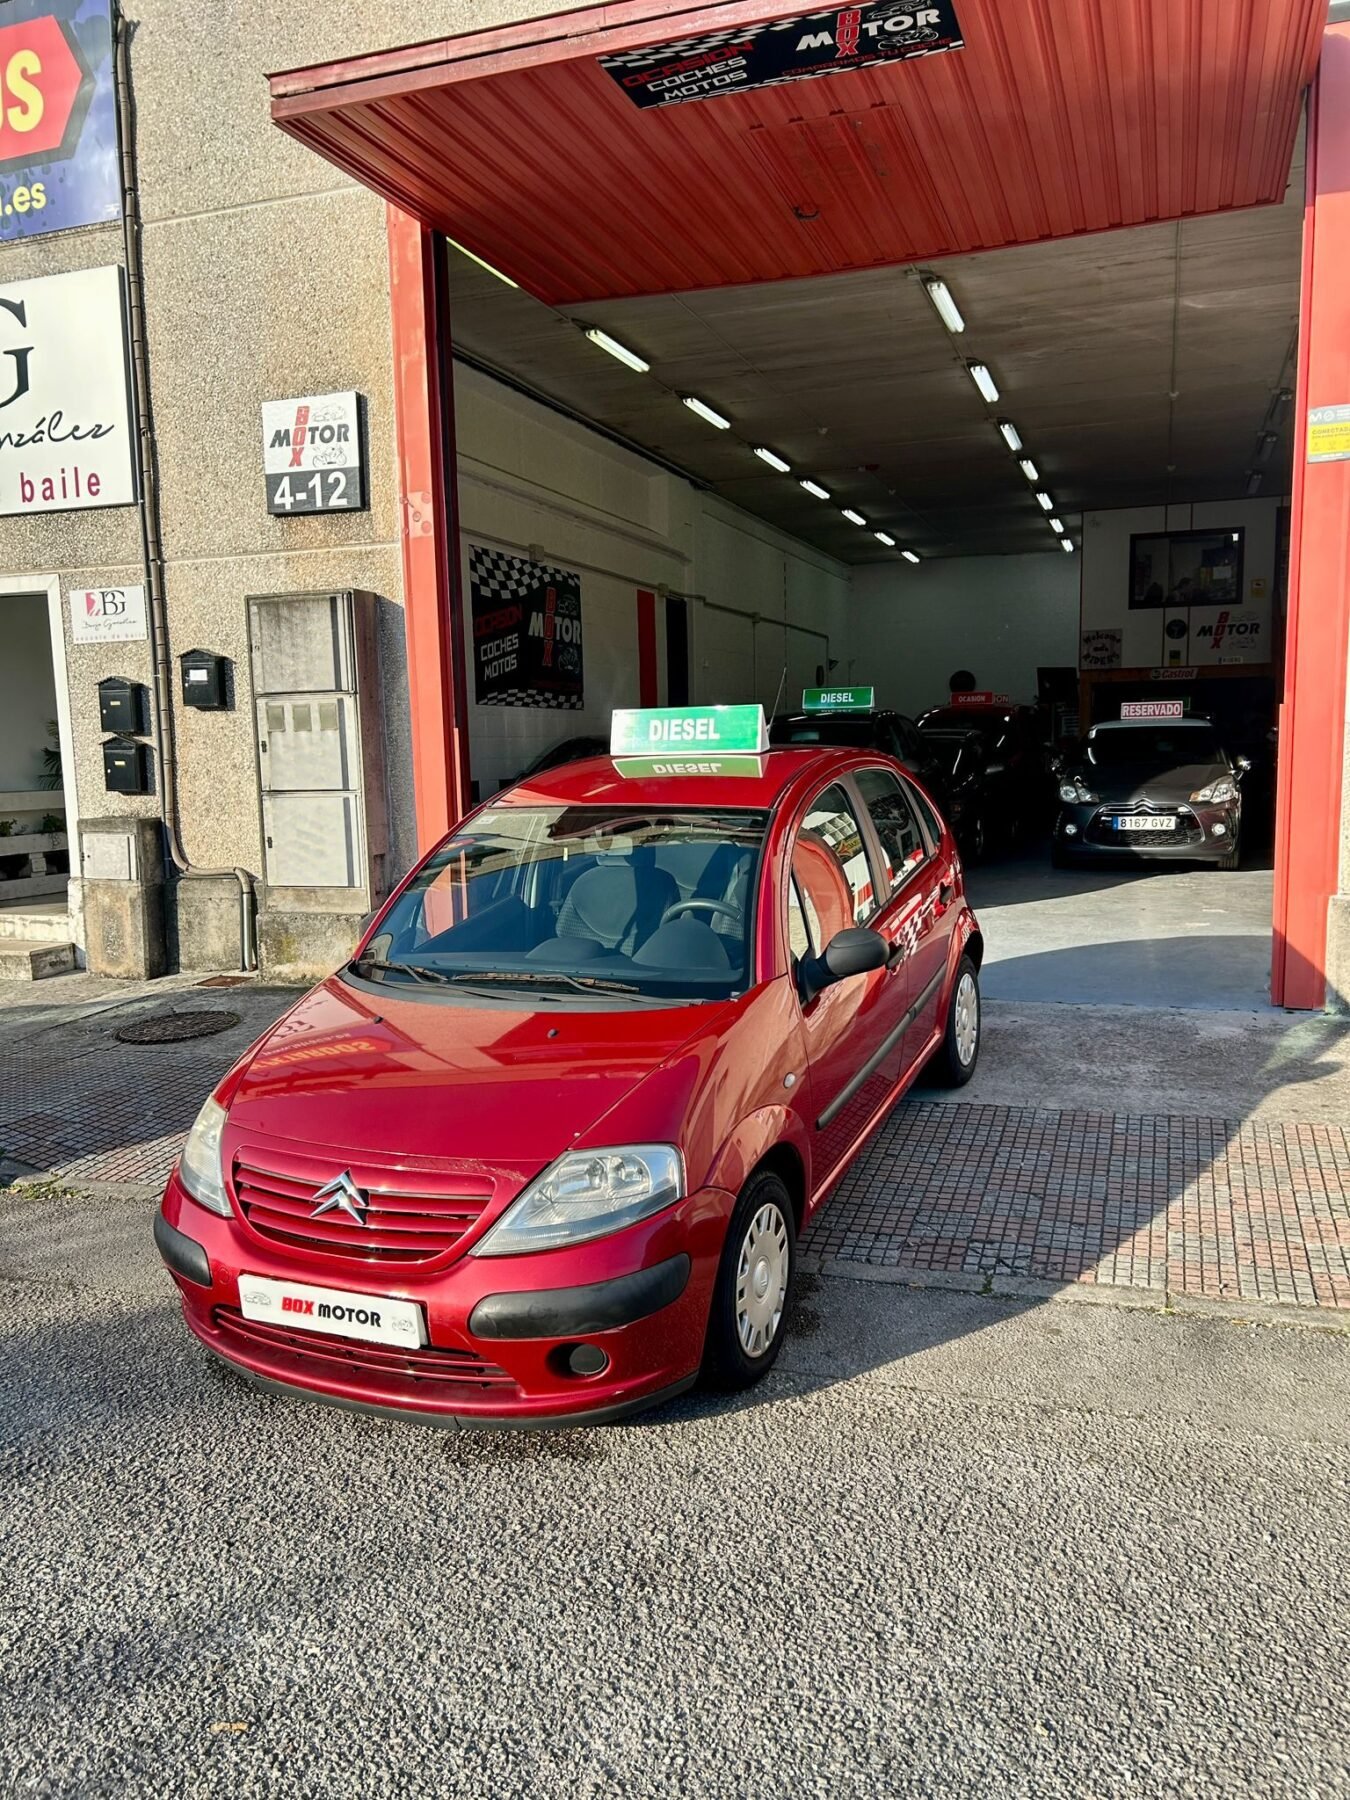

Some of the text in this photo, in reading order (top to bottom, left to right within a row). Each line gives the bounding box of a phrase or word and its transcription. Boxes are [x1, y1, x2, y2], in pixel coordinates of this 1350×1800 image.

[796, 8, 941, 51] MOTOR
[835, 8, 861, 58] BOX
[622, 41, 754, 87] OCASION
[647, 56, 747, 92] COCHES
[664, 70, 748, 101] MOTOS
[269, 423, 350, 449] MOTOR
[288, 405, 310, 468] BOX
[20, 466, 101, 503] baile
[273, 471, 349, 510] 4-12
[99, 590, 127, 616] BG
[528, 611, 582, 645] MOTOR
[542, 586, 557, 667] BOX
[1197, 622, 1260, 637] MOTOR
[1211, 612, 1230, 649] BOX
[480, 633, 519, 662] COCHES
[484, 653, 518, 681] MOTOS
[1161, 669, 1195, 679] Castrol
[820, 693, 854, 704] DIESEL
[1122, 704, 1181, 717] RESERVADO
[649, 718, 720, 741] DIESEL
[1120, 818, 1173, 828] 8167 GVZ
[282, 1296, 382, 1328] BOX MOTOR
